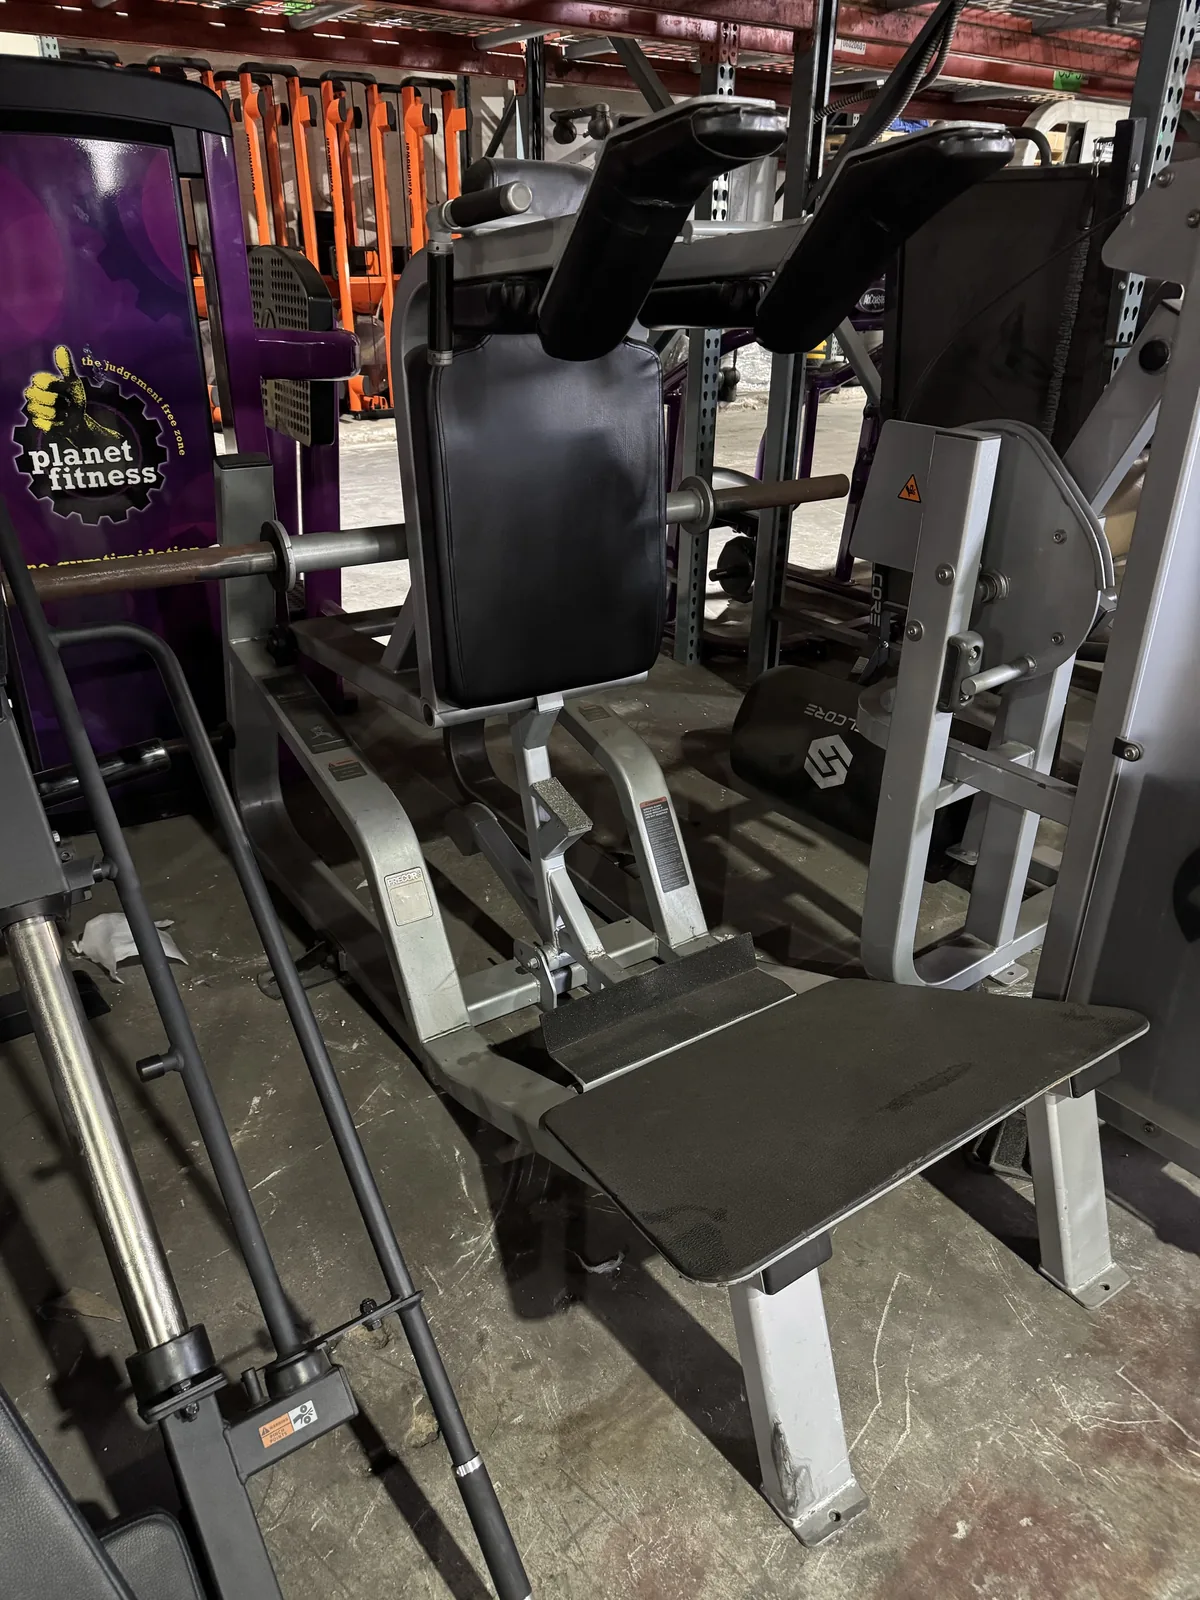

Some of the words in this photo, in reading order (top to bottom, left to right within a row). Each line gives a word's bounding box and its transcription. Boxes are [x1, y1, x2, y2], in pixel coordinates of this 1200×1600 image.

[863, 293, 885, 305] AbCoaste
[81, 355, 101, 368] the
[104, 360, 163, 404] judgement
[161, 403, 177, 427] free
[174, 429, 185, 456] zone
[28, 440, 134, 475] planet
[48, 466, 157, 491] fitness
[870, 561, 883, 627] CORE
[803, 703, 860, 733] LCORE
[387, 870, 418, 887] PRECOR
[270, 1428, 285, 1438] PINCH
[270, 1431, 288, 1443] POINTS
